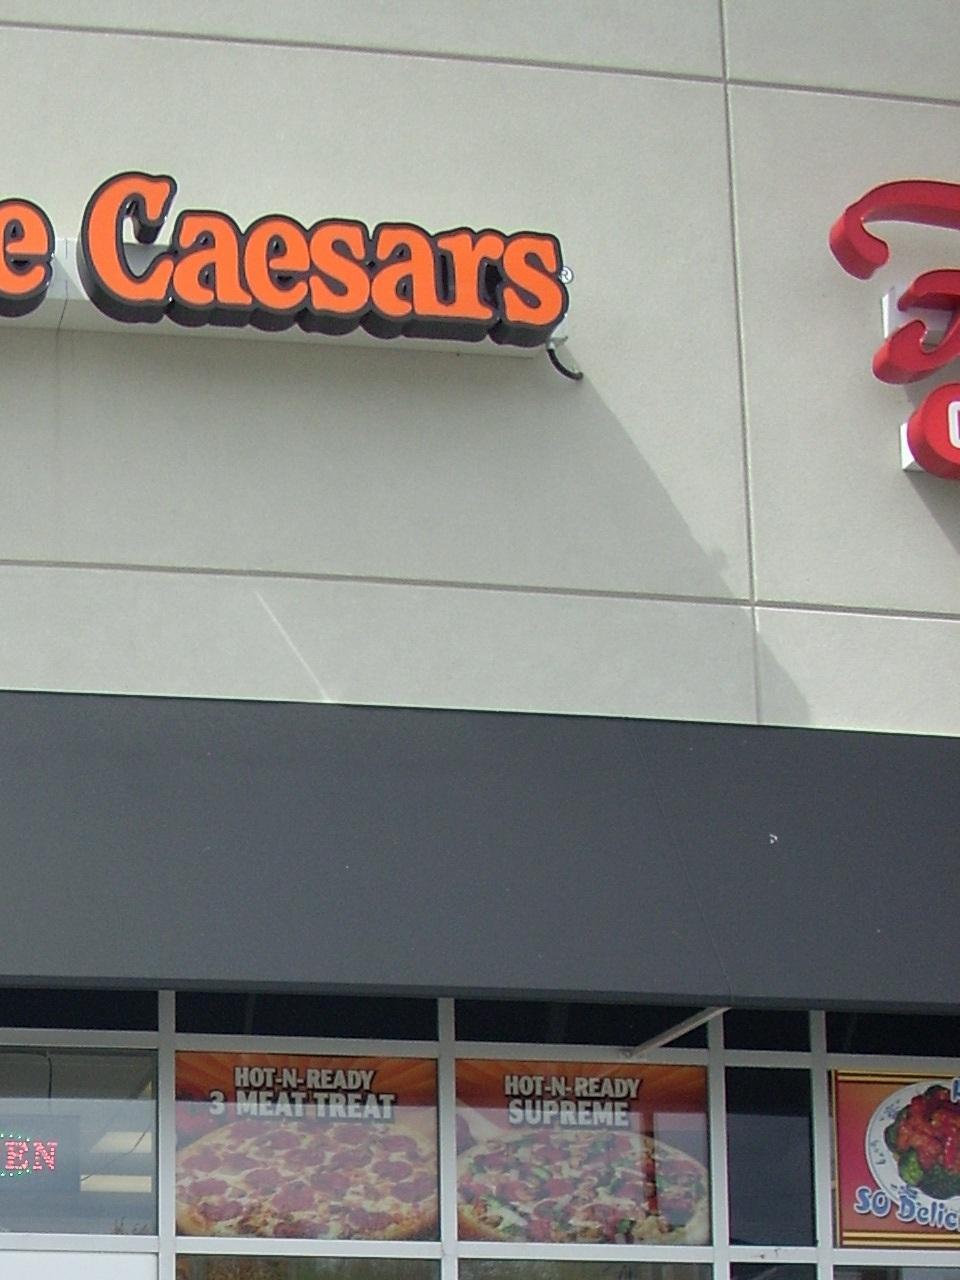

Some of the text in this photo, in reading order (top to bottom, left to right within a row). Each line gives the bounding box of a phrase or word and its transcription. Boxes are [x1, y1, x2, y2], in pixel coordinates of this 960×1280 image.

[80, 170, 569, 328] Caesars
[233, 1066, 375, 1092] HOT-N-READY
[504, 1074, 642, 1100] HOT-N-READY
[209, 1090, 396, 1120] 3 MEAT TREAT
[507, 1100, 630, 1128] SUPREME
[897, 1194, 960, 1233] Delic
